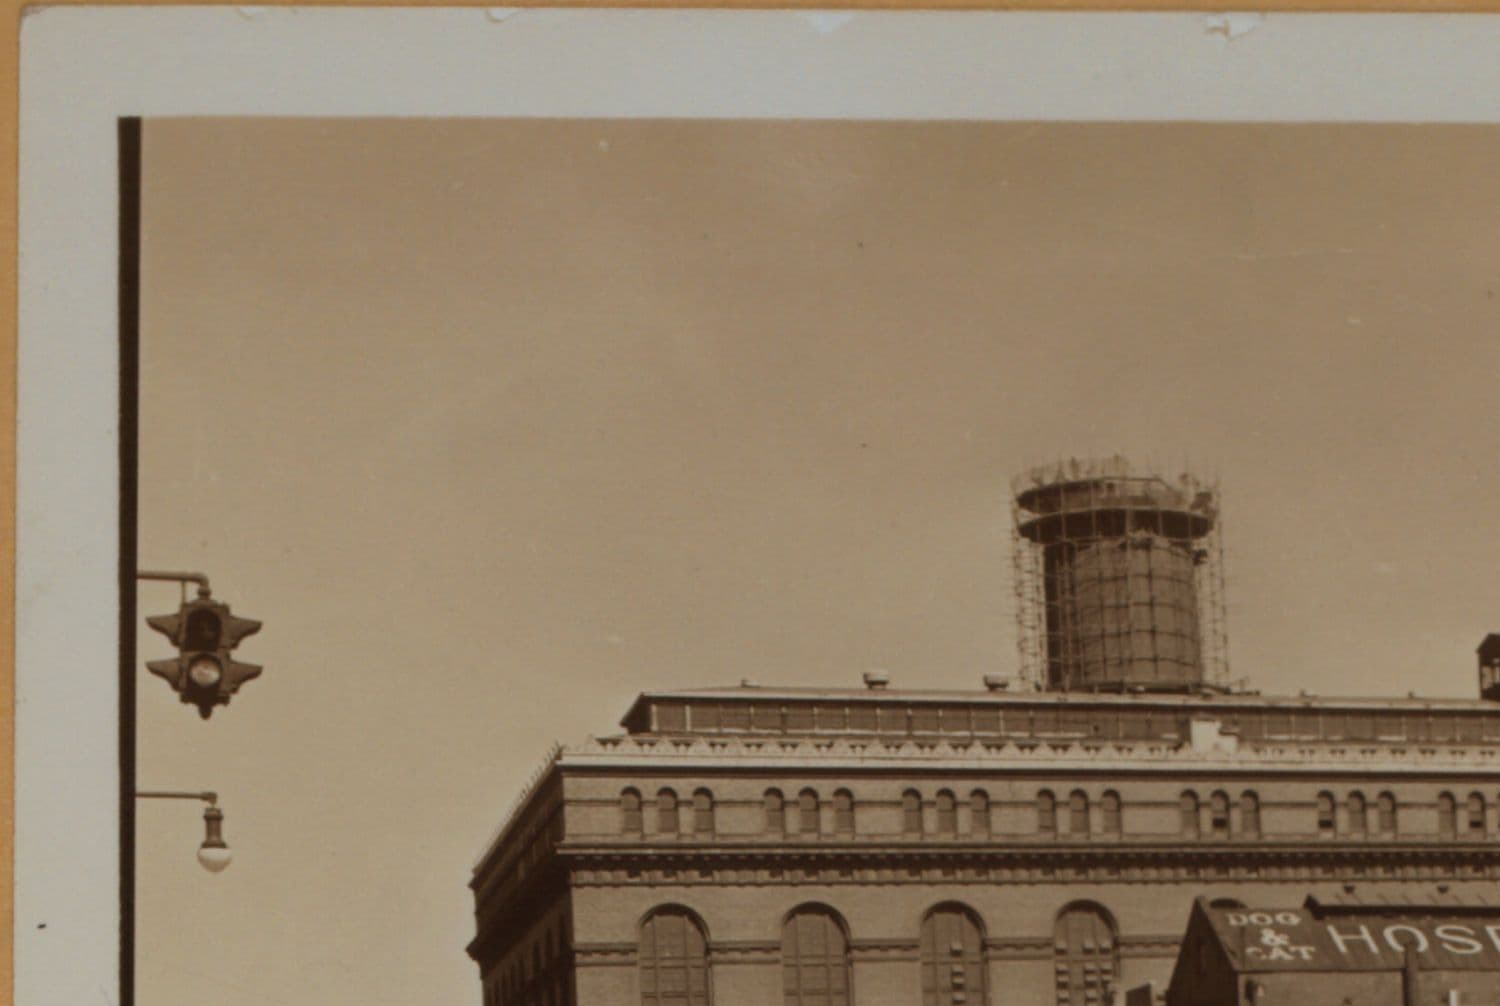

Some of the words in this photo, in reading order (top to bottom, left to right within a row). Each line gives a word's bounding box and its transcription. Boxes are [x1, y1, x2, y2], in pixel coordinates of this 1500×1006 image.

[1225, 911, 1302, 926] DOG
[1260, 928, 1289, 946] &
[1245, 946, 1316, 960] CAT
